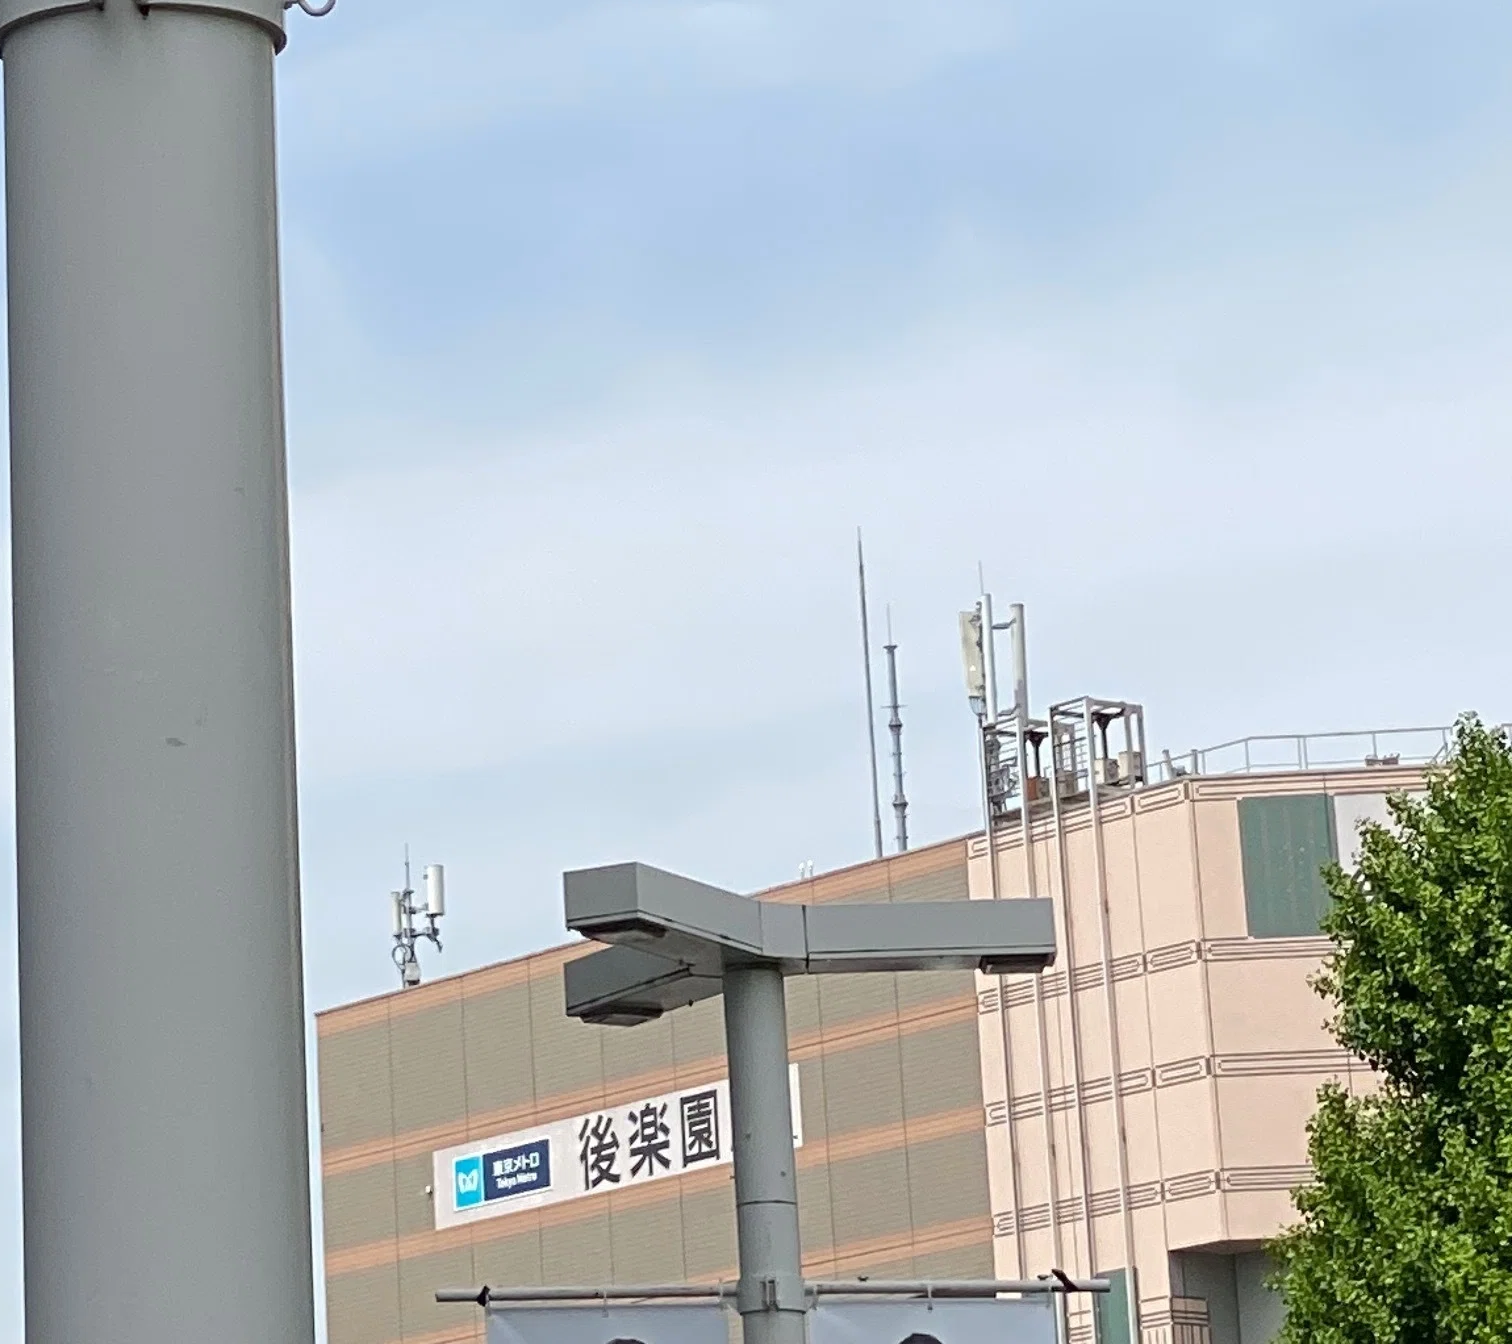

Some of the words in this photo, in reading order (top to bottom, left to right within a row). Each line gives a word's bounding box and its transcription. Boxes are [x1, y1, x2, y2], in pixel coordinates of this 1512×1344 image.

[492, 1152, 540, 1176] 東京メトロ
[579, 1089, 734, 1190] 後楽園
